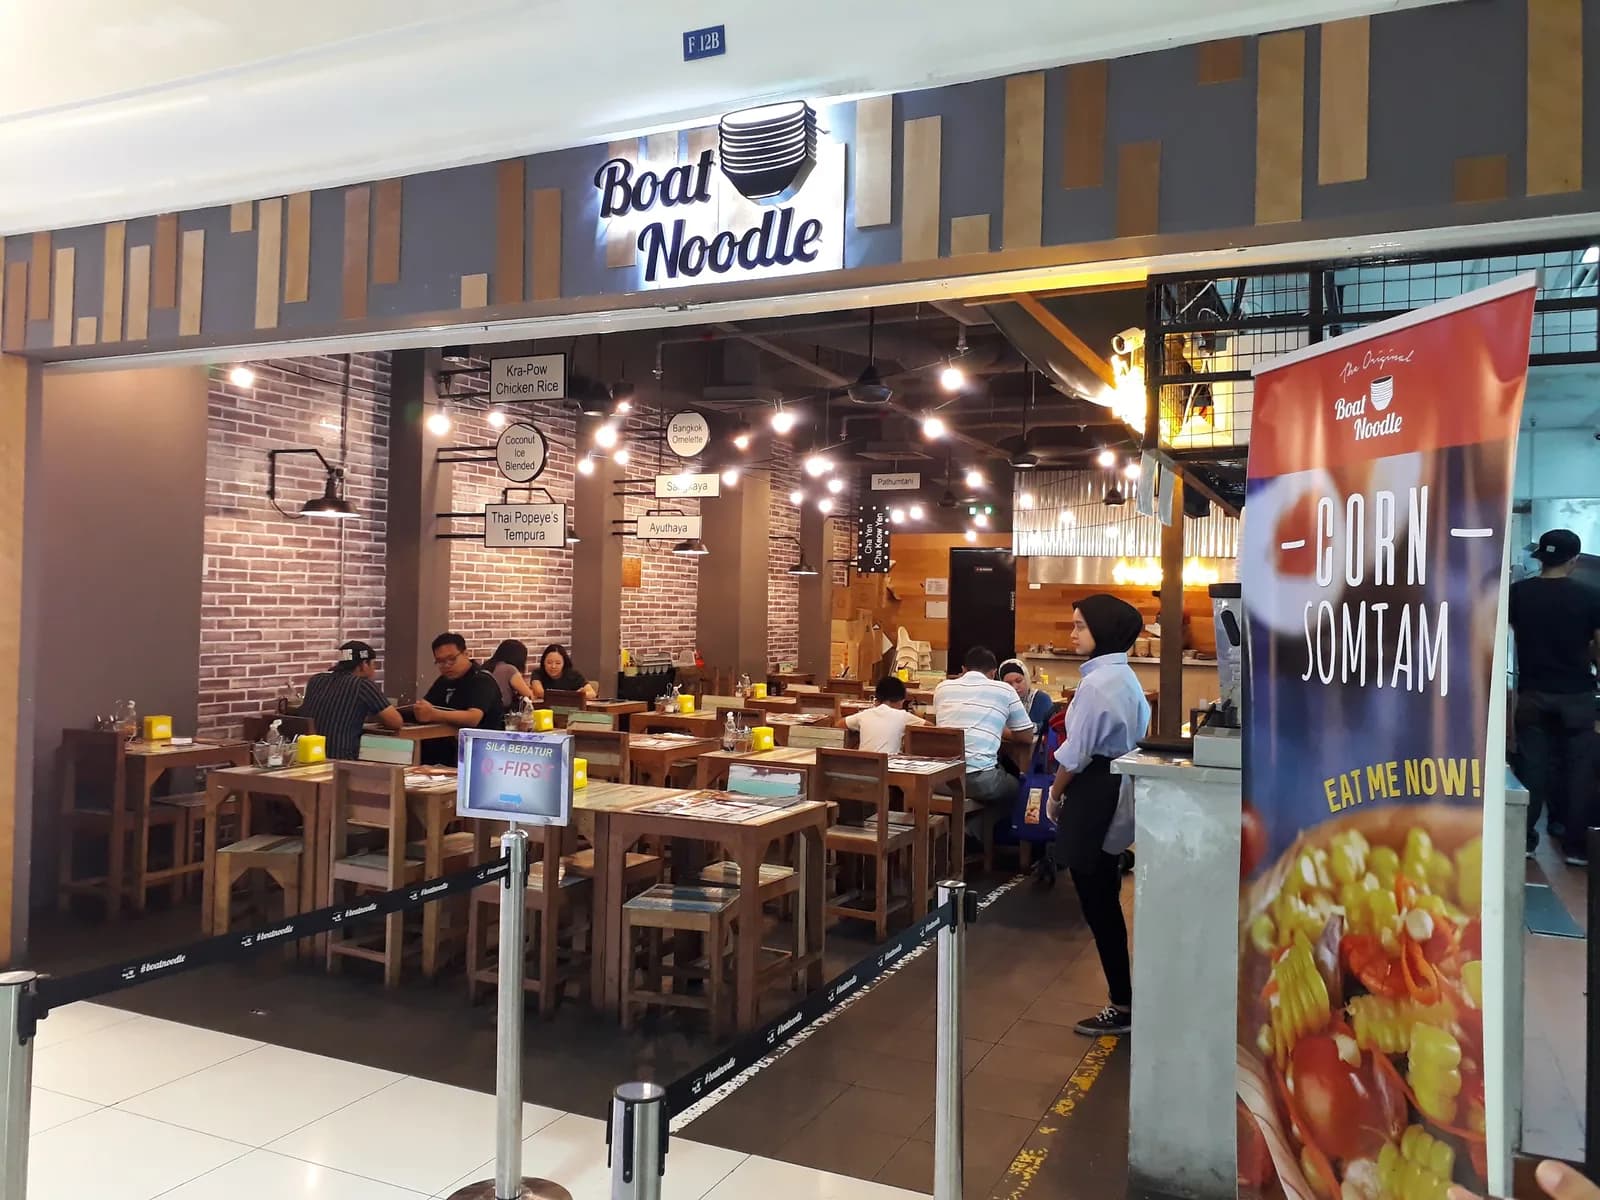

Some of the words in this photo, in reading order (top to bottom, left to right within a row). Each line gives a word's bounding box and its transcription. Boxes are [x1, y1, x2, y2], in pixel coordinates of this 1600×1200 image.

[688, 36, 696, 53] F
[700, 31, 720, 51] 12B
[594, 149, 716, 219] Boat
[637, 207, 823, 281] Noodle
[506, 363, 547, 376] Kra-Pow
[1339, 361, 1359, 383] The
[1362, 348, 1415, 370] Original
[495, 381, 534, 395] Chicken
[537, 380, 559, 392] Rice
[1334, 394, 1367, 420] Boat
[672, 423, 703, 434] Bangkok
[1353, 412, 1403, 440] Noodle
[505, 435, 535, 445] Coconut
[672, 434, 703, 444] Omelette
[514, 448, 526, 458] Ice
[505, 461, 535, 471] Blended
[491, 511, 512, 524] Thai
[515, 511, 559, 527] Popeye's
[876, 512, 884, 527] Yen
[504, 528, 545, 542] Tempura
[649, 522, 688, 534] Ayuthaya
[864, 523, 873, 537] Yen
[1316, 485, 1429, 586] CORN
[864, 538, 873, 554] Cha
[874, 550, 882, 565] Cha
[1301, 600, 1449, 696] SOMTAM
[485, 741, 506, 752] SILA
[508, 743, 553, 757] BERATUR
[1323, 768, 1363, 813] EAT
[1366, 760, 1400, 801] ME
[1404, 757, 1481, 798] NOW!
